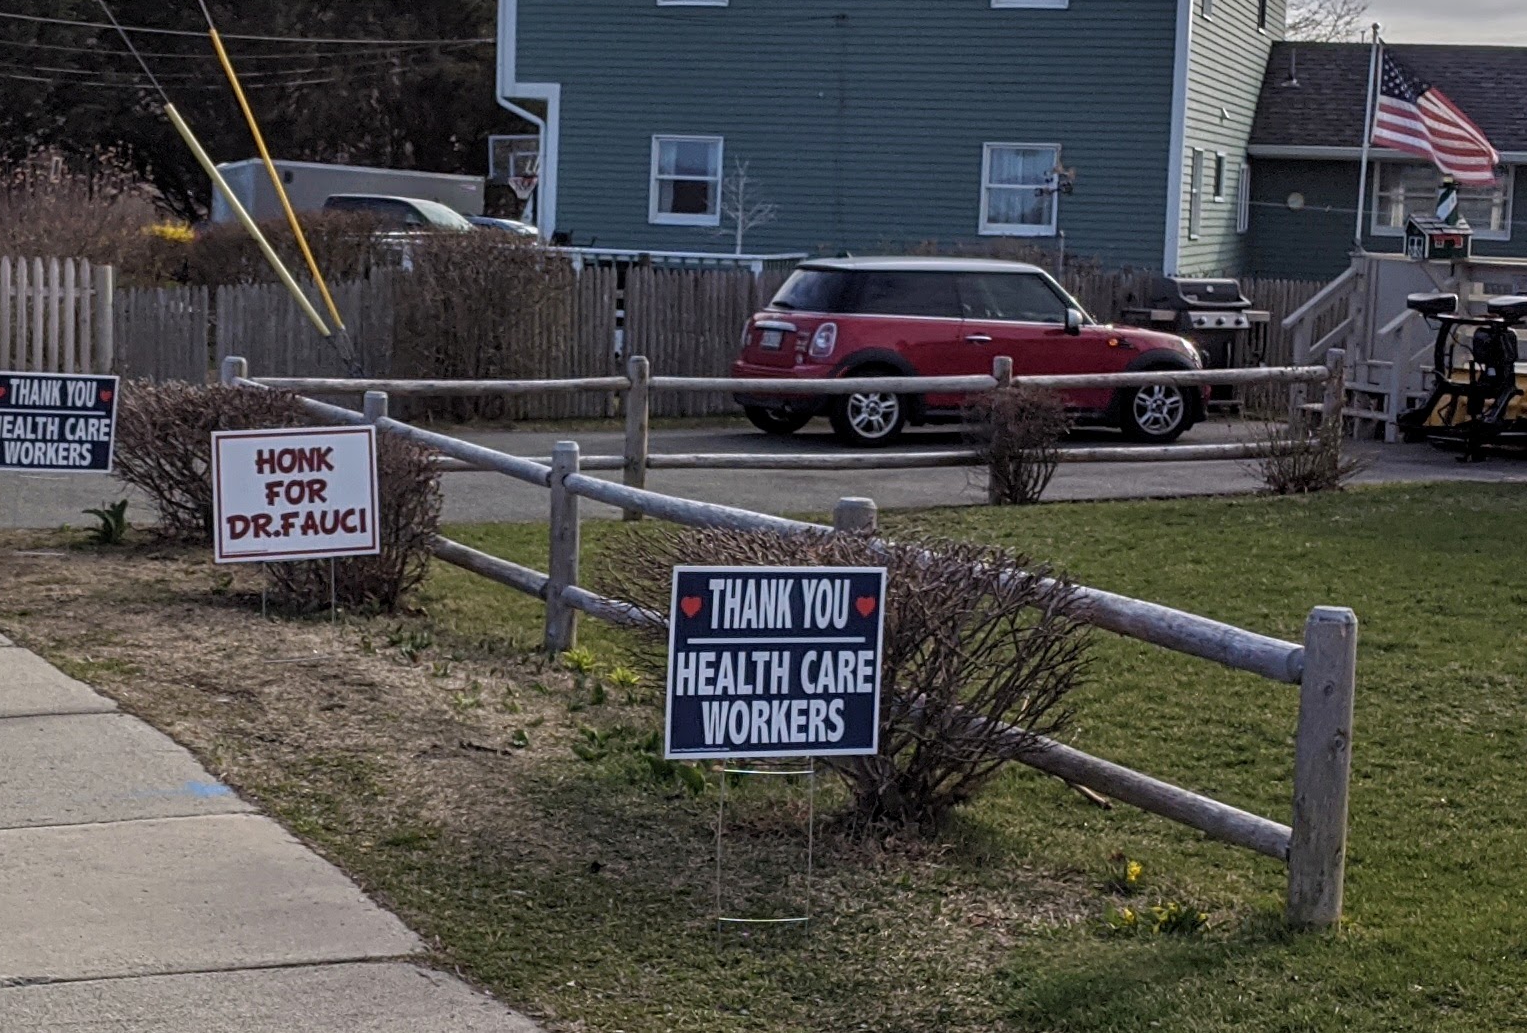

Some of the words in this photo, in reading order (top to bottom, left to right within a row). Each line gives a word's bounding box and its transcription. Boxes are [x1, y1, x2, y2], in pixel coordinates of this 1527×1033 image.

[9, 378, 62, 407] THANK
[66, 380, 98, 408] YOU
[64, 418, 111, 442] CARE
[4, 441, 92, 466] WORKERS
[255, 446, 335, 475] HONK
[265, 478, 328, 507] FOR
[709, 578, 795, 630] THANK
[802, 578, 851, 630] YOU
[675, 650, 791, 696] HEALTH
[800, 650, 875, 695] CARE
[701, 698, 846, 746] WORKERS
